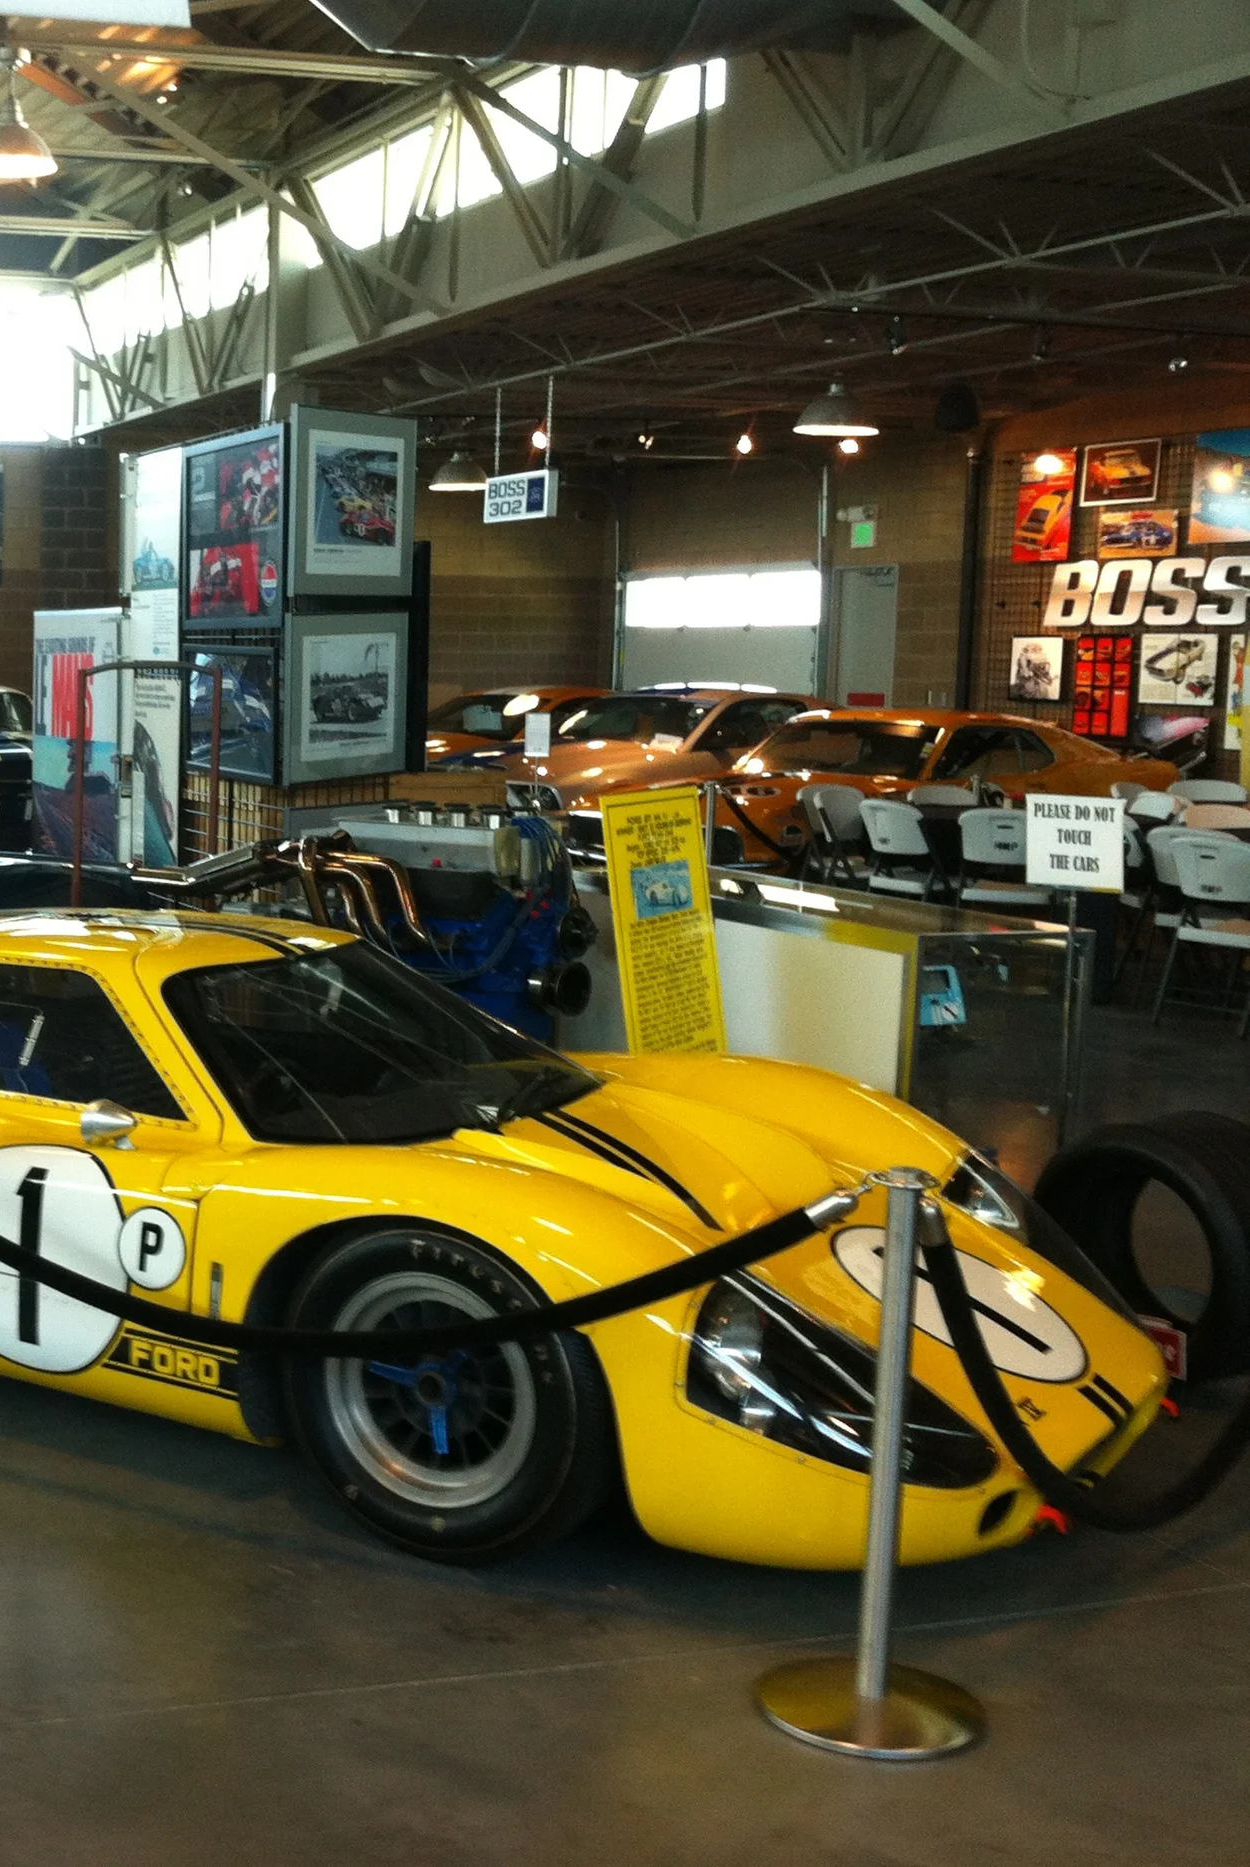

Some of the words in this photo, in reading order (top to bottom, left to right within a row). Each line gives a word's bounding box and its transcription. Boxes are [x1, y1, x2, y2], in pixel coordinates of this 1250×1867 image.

[489, 480, 525, 499] BOSS
[489, 500, 522, 516] 302
[1043, 556, 1250, 625] BOSS
[1034, 803, 1072, 821] PLEASE
[1075, 806, 1091, 821] DO
[1094, 807, 1115, 823] NOT
[1057, 829, 1091, 846] TOUCH
[1050, 854, 1070, 870] THE
[1073, 857, 1100, 873] CARS
[16, 1166, 49, 1346] 1
[138, 1221, 164, 1272] P
[131, 1340, 220, 1386] FORD
